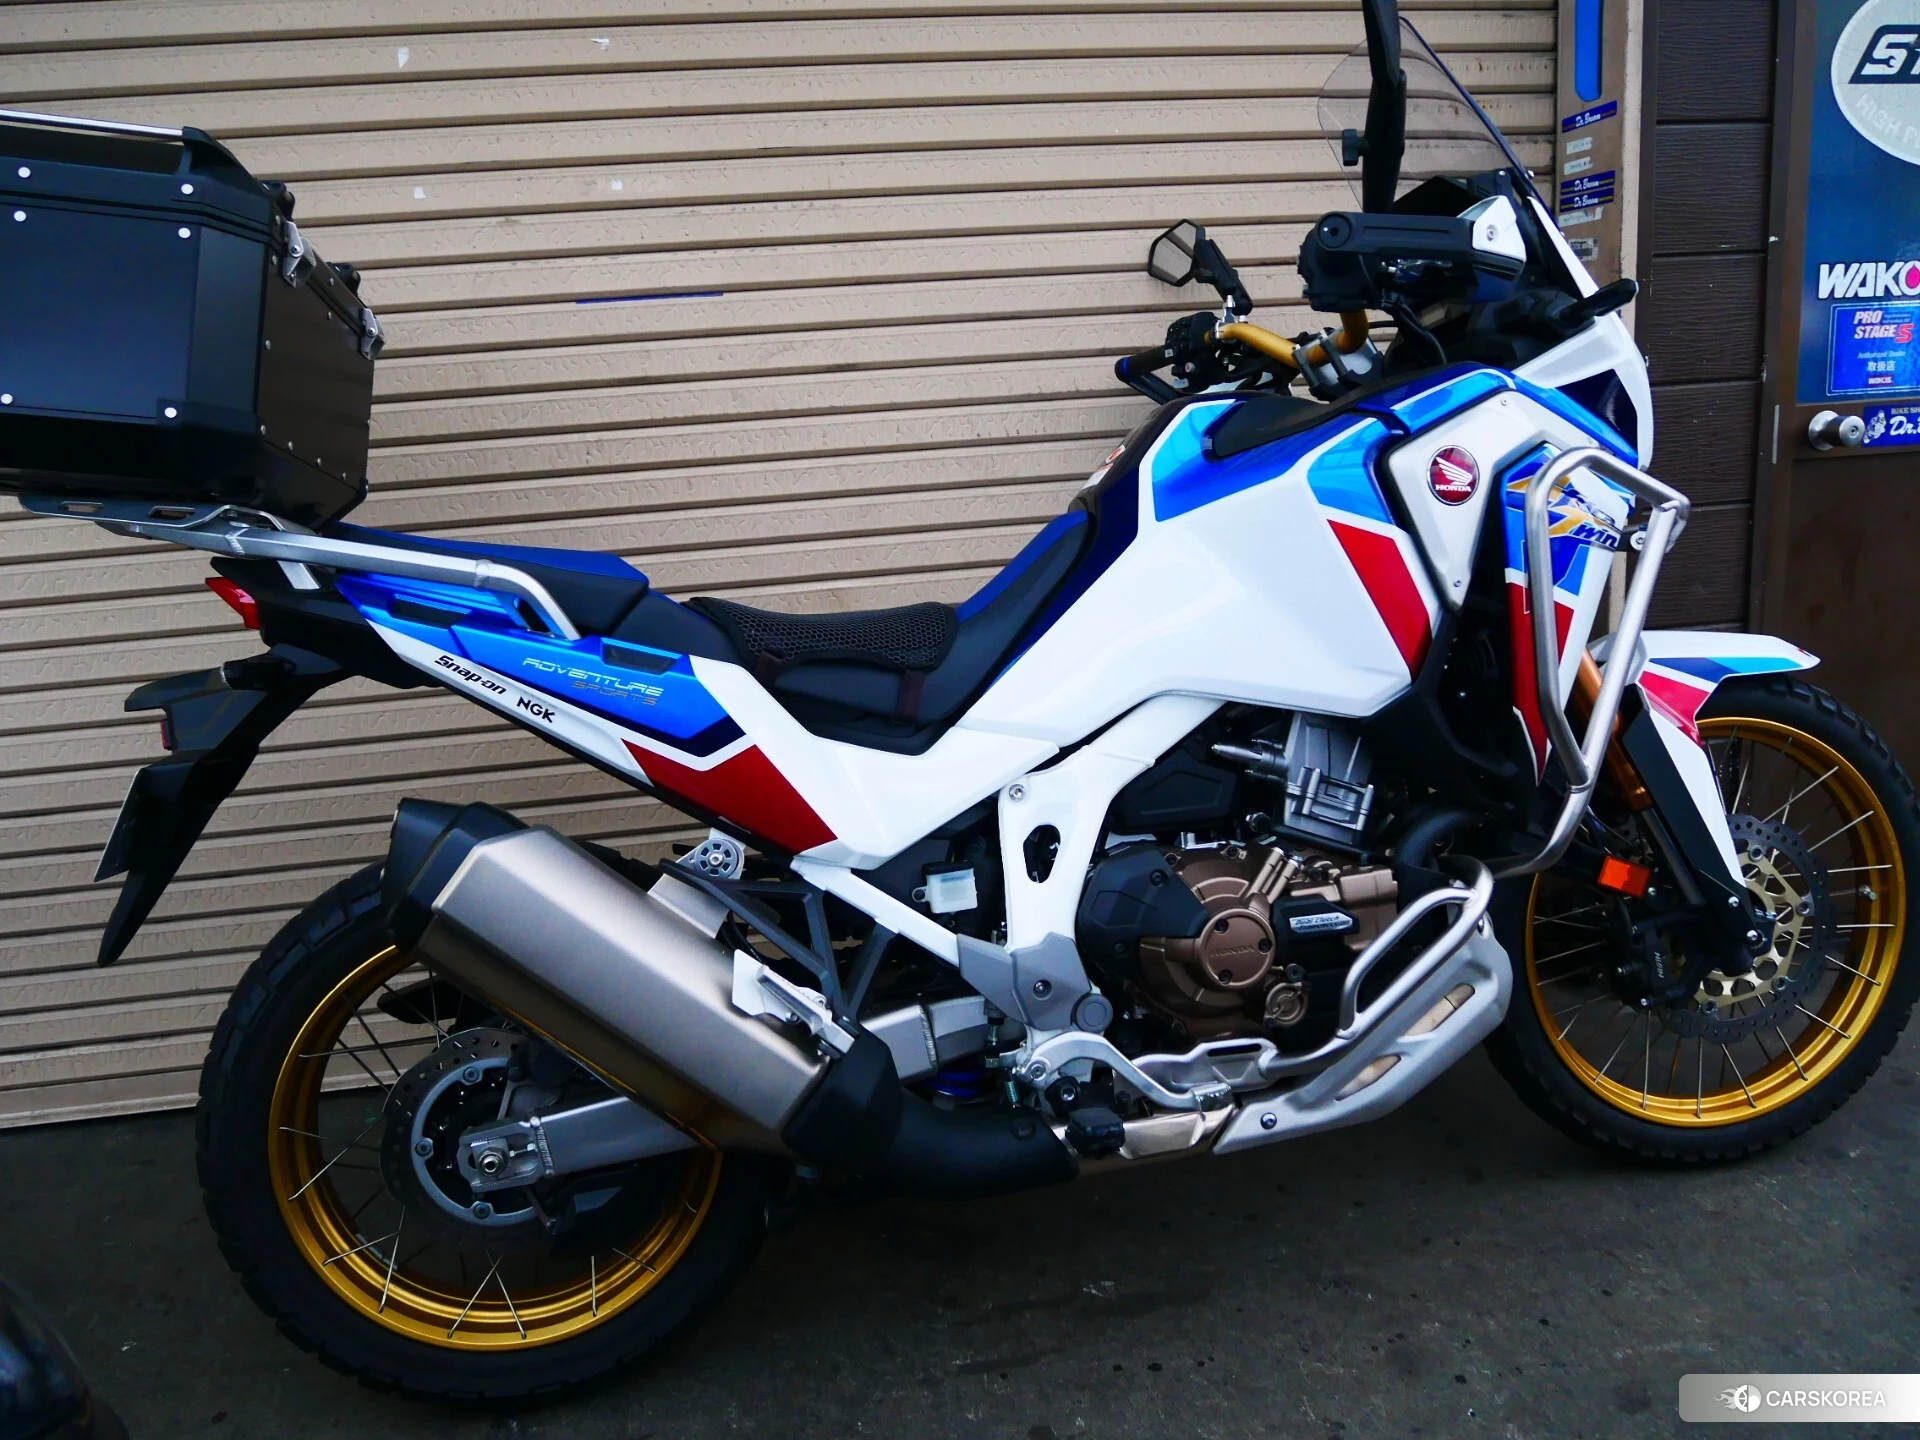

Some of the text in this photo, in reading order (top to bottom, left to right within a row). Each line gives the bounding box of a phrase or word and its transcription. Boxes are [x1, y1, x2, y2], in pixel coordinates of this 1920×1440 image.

[1855, 93, 1901, 137] HIGH
[1853, 310, 1882, 324] PRO
[1854, 324, 1897, 339] STAGE
[434, 655, 507, 695] Snap-on
[522, 657, 664, 697] ADVENTURE
[571, 680, 658, 706] SPORTS
[517, 696, 555, 723] NGK
